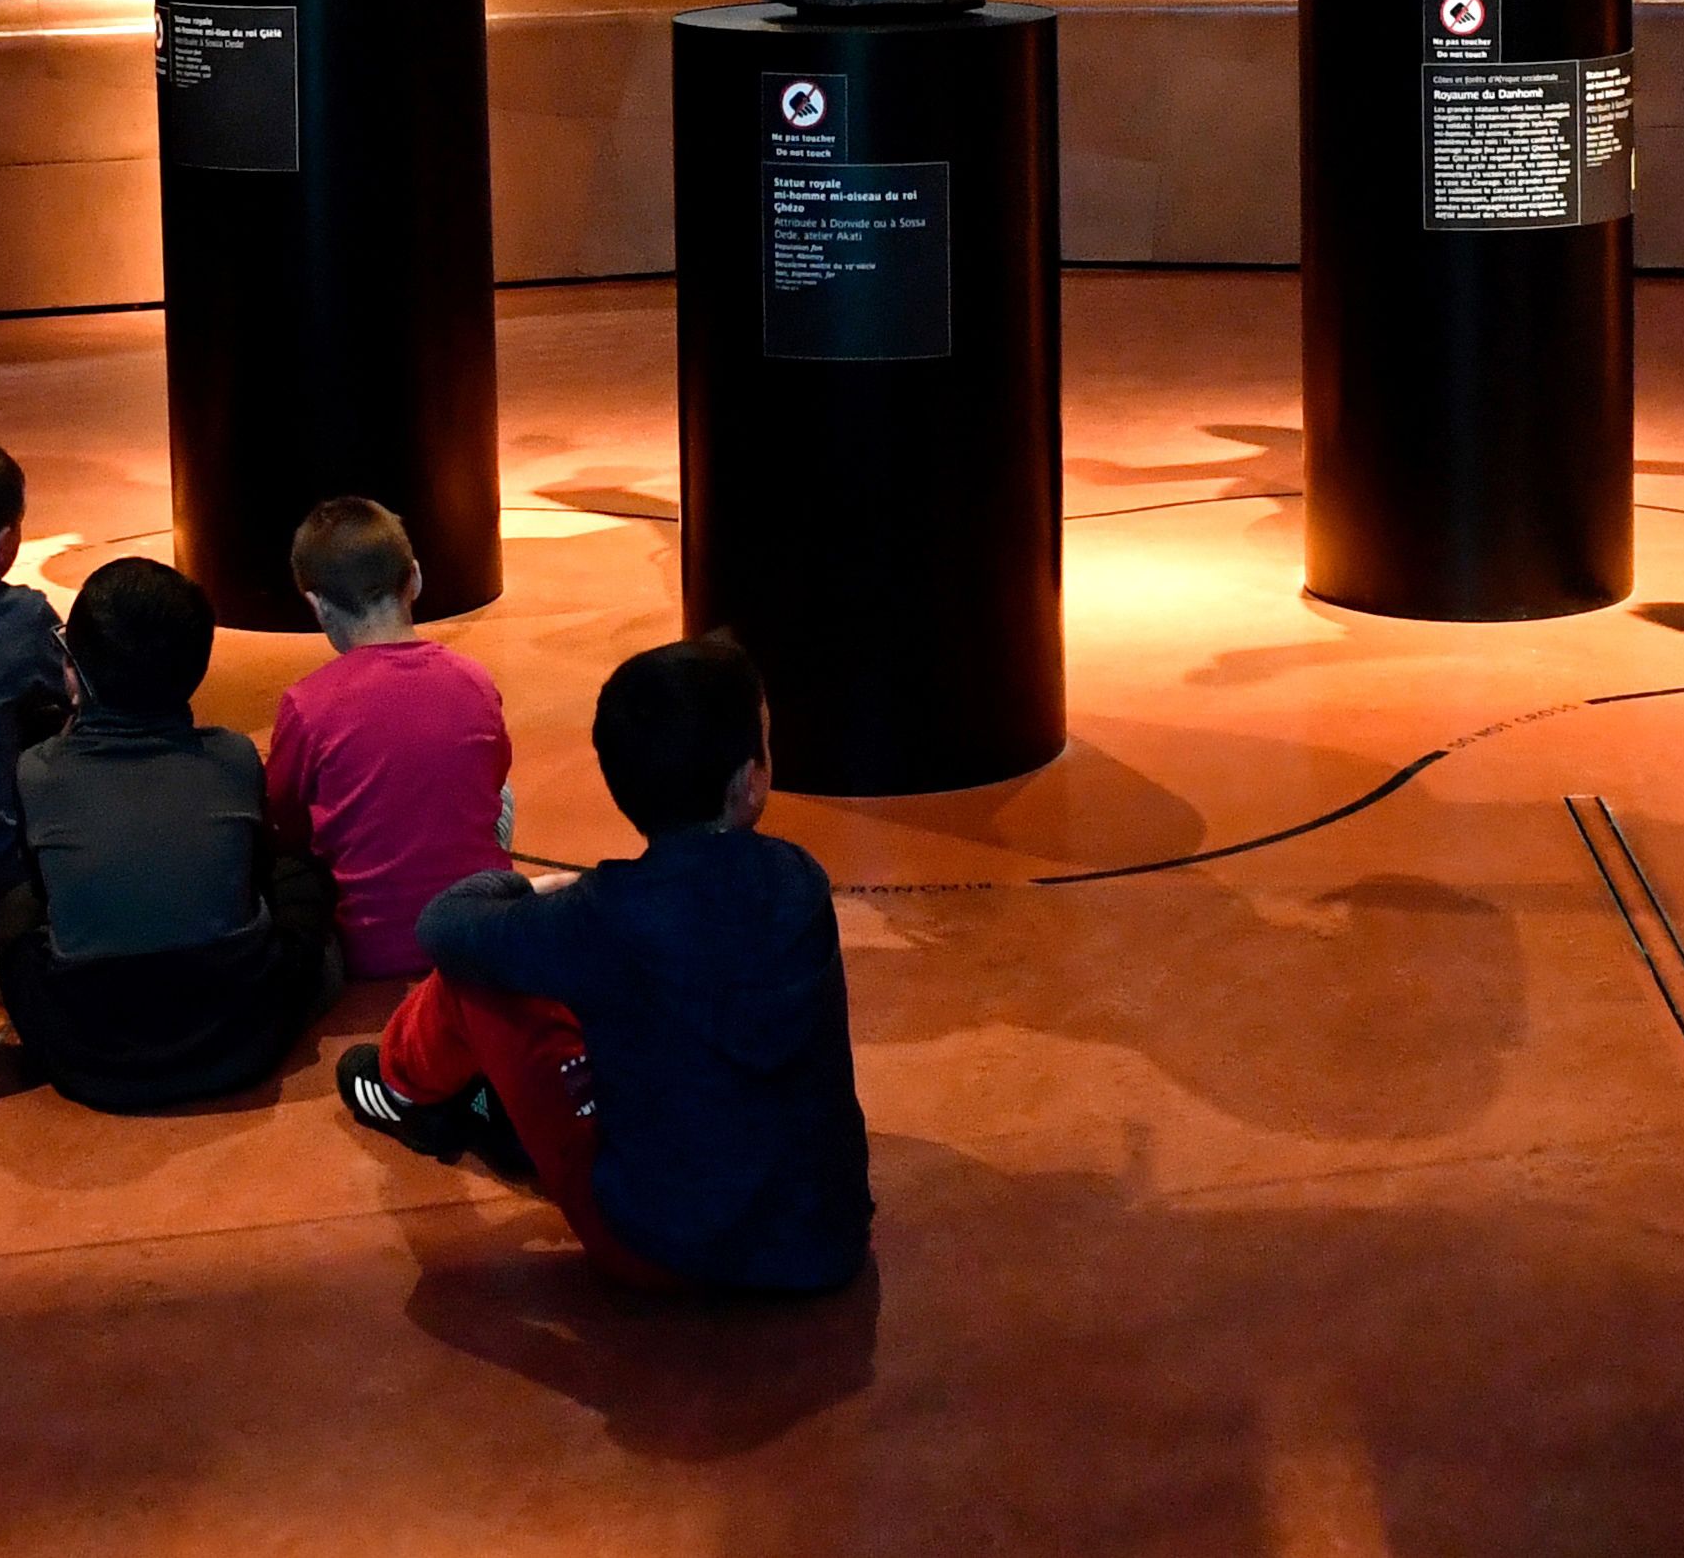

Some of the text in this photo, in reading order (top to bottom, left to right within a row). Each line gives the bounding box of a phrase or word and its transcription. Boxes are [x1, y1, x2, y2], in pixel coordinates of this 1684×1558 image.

[232, 29, 243, 37] du
[1434, 88, 1543, 101] Royaume du Danhomè
[772, 133, 835, 143] Ne pas toucher
[776, 148, 787, 156] Do
[807, 149, 831, 158] touch
[774, 177, 841, 190] Statue royale
[774, 190, 917, 201] mi-homme mi-oiseau du roi
[900, 217, 926, 227] Sossa
[804, 231, 833, 240] atelier
